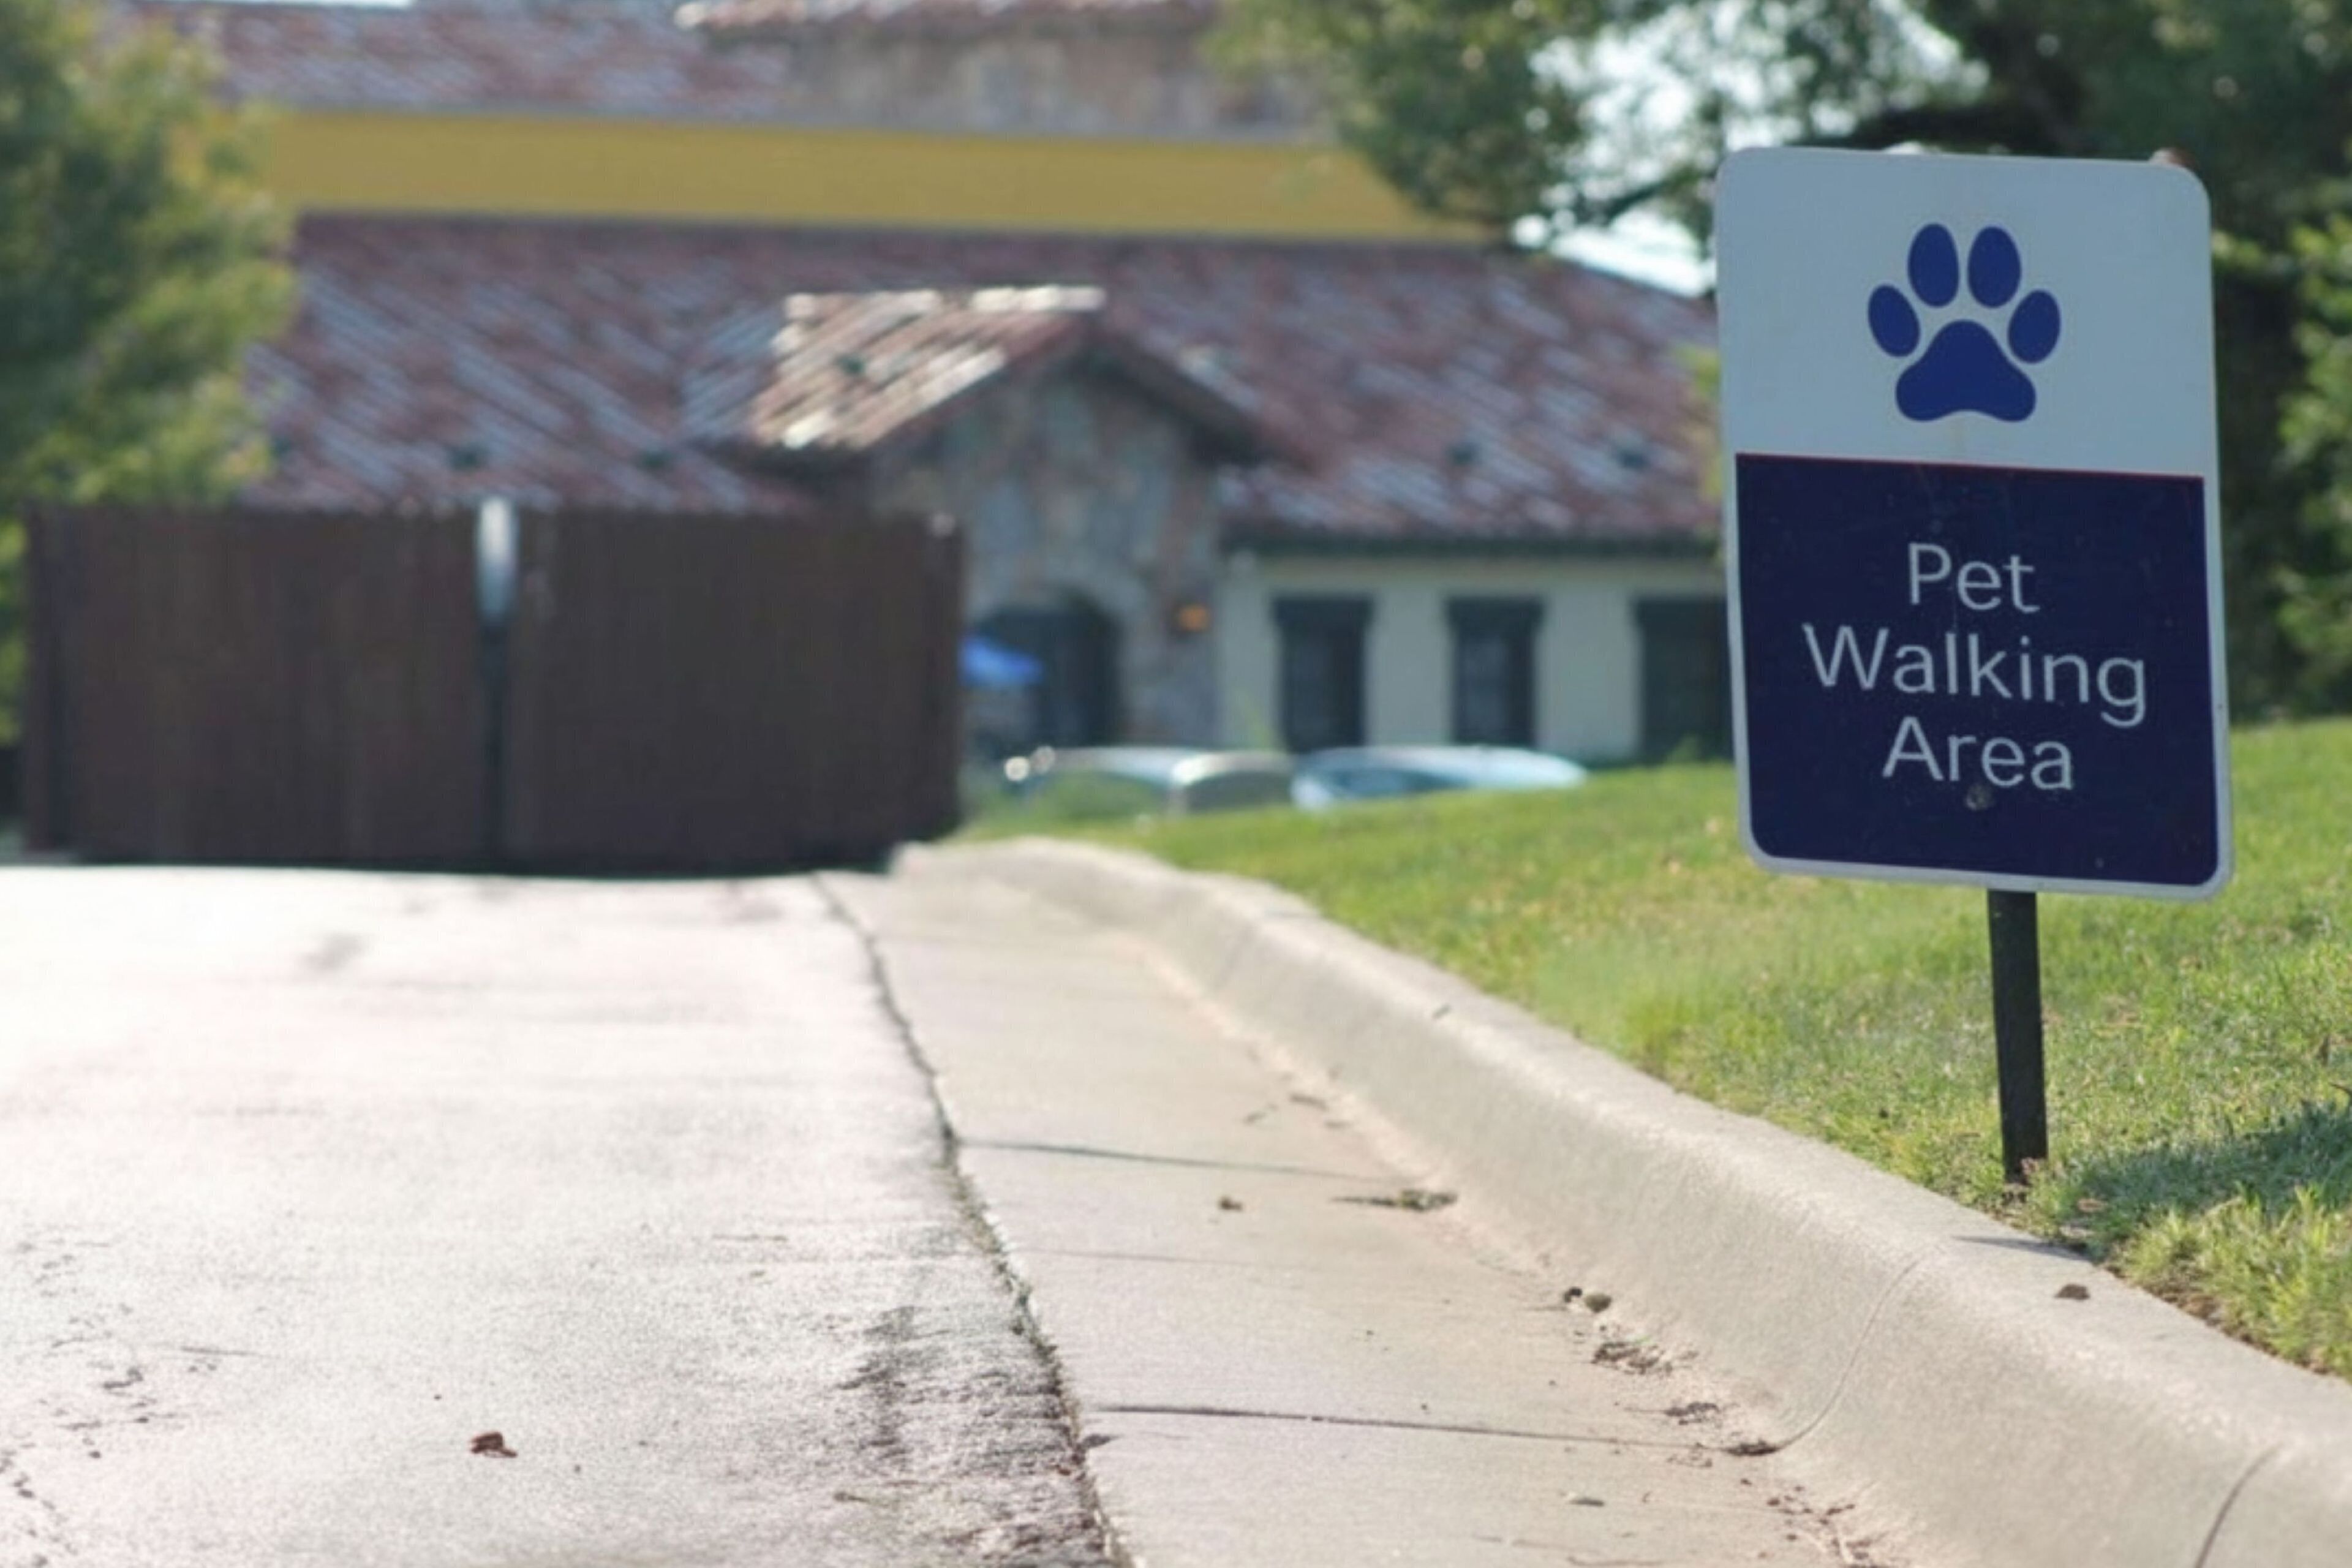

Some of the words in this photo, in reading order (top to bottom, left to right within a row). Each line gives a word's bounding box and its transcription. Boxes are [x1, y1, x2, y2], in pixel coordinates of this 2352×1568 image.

[1908, 542, 2040, 614] Pet
[1803, 624, 2147, 728] Walking
[1882, 715, 2074, 791] Area
